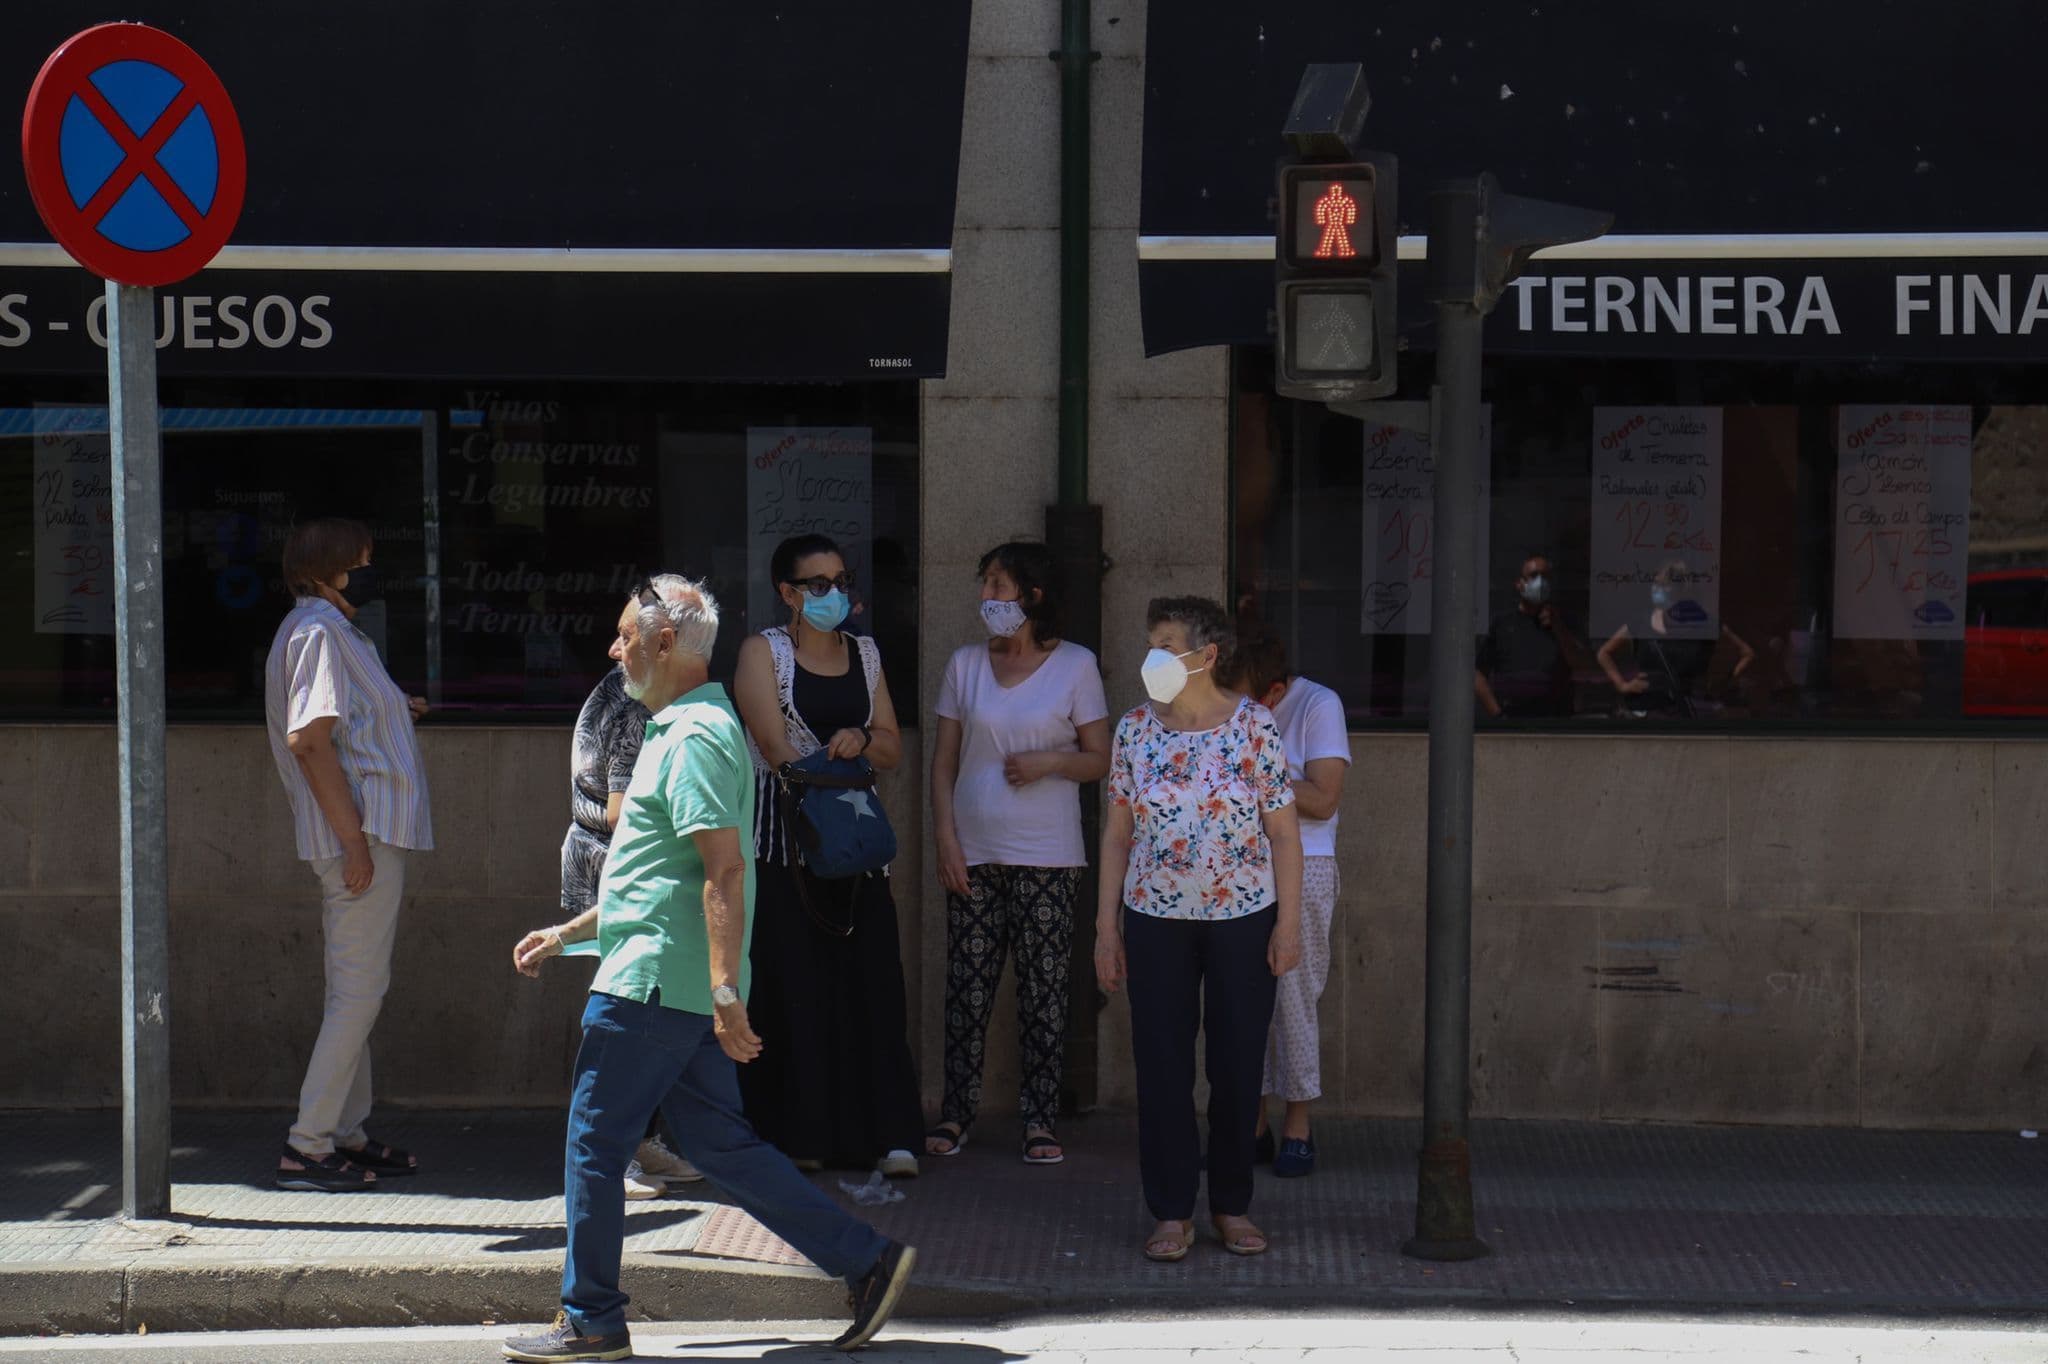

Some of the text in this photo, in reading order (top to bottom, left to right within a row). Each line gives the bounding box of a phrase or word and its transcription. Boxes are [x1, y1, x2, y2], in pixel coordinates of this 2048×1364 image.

[1508, 274, 2048, 335] TERNERA FINA
[869, 358, 913, 368] TORNASOL
[448, 431, 641, 465] -Conservas
[1600, 415, 1645, 449] Oferta
[1847, 412, 1894, 449] Oferta
[755, 434, 797, 470] Oferta
[448, 473, 654, 512] -Legumbres
[555, 570, 596, 594] en
